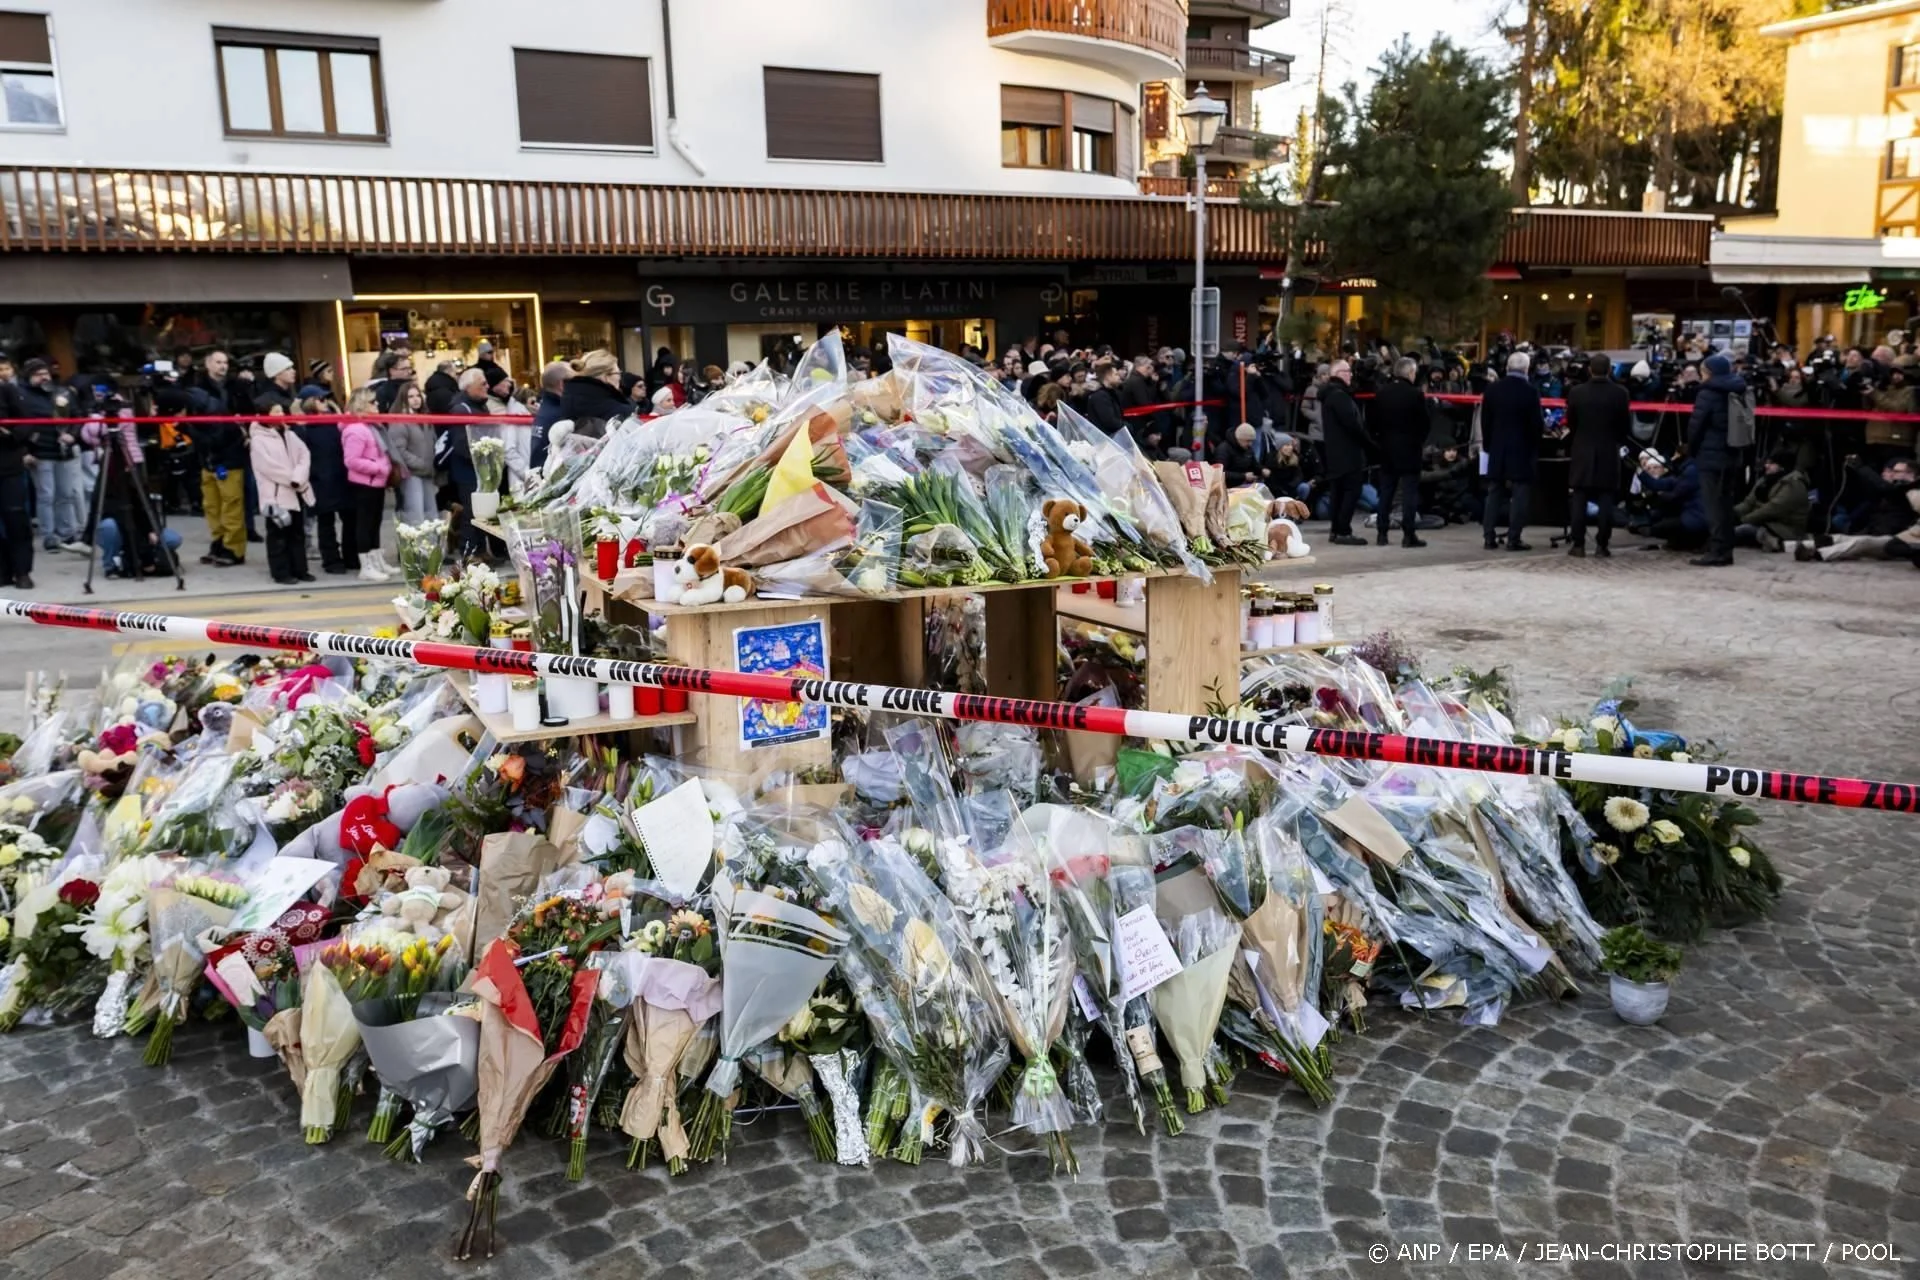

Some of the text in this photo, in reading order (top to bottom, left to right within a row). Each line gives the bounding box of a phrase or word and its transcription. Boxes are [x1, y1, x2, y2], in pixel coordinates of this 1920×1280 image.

[730, 281, 996, 303] GALERIE PLATINI
[1340, 277, 1377, 288] AVENUE
[760, 306, 803, 317] CRANS
[808, 305, 867, 315] MONTANA
[218, 623, 413, 658] POLICE ZONE INTERDITE
[474, 648, 713, 690] POLICE ZONE INTERDITE
[790, 679, 1087, 728] POLICE ZONE INTERDITE
[1188, 716, 1572, 778] POLICE ZONE INTERDITE
[1706, 766, 1920, 813] POLICE ZO
